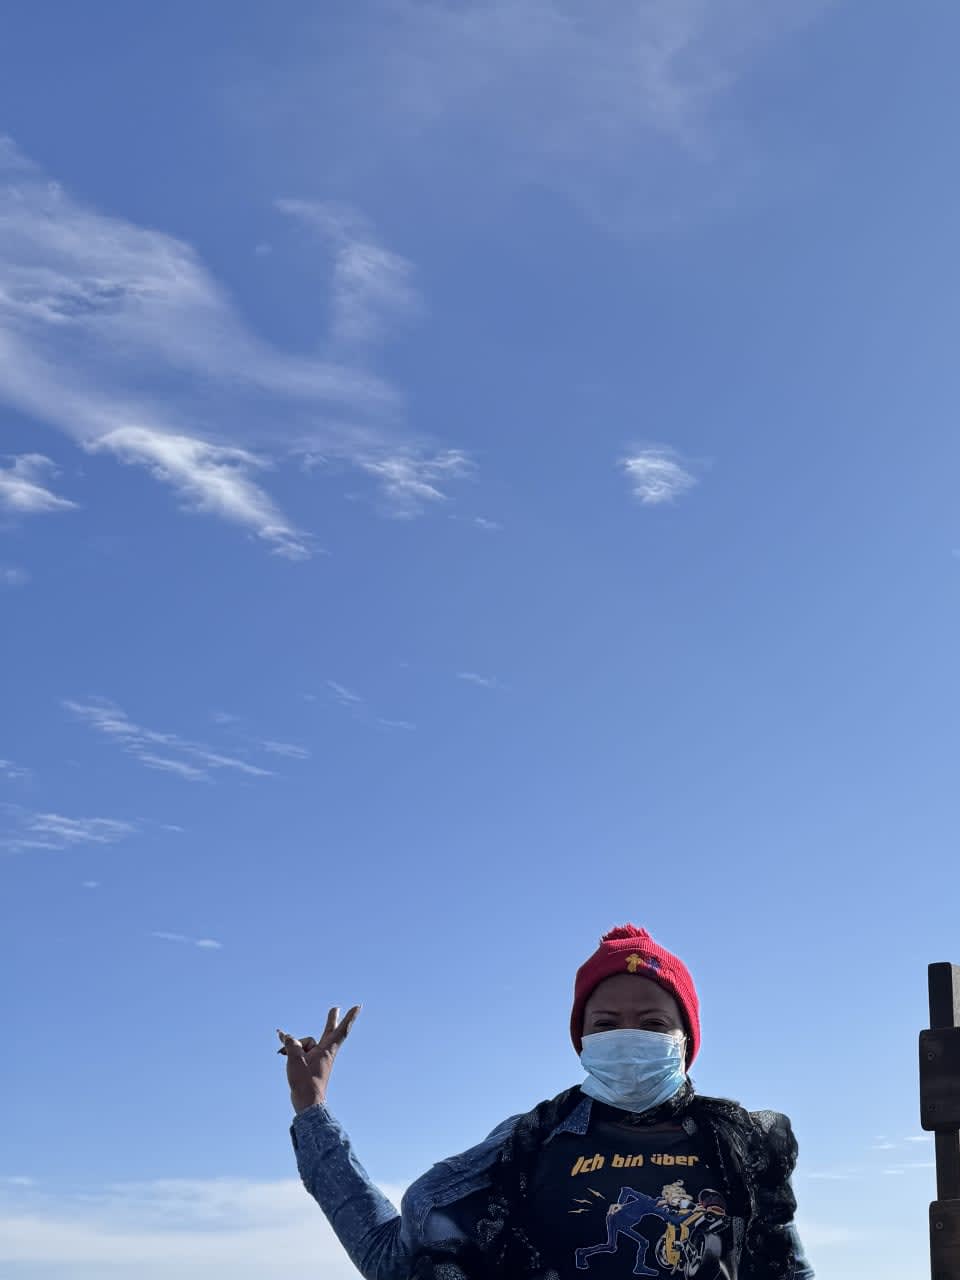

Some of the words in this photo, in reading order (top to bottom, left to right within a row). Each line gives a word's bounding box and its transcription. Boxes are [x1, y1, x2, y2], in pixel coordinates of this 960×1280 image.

[571, 1153, 605, 1176] Ich
[611, 1153, 644, 1168] bin
[651, 1154, 699, 1167] über
